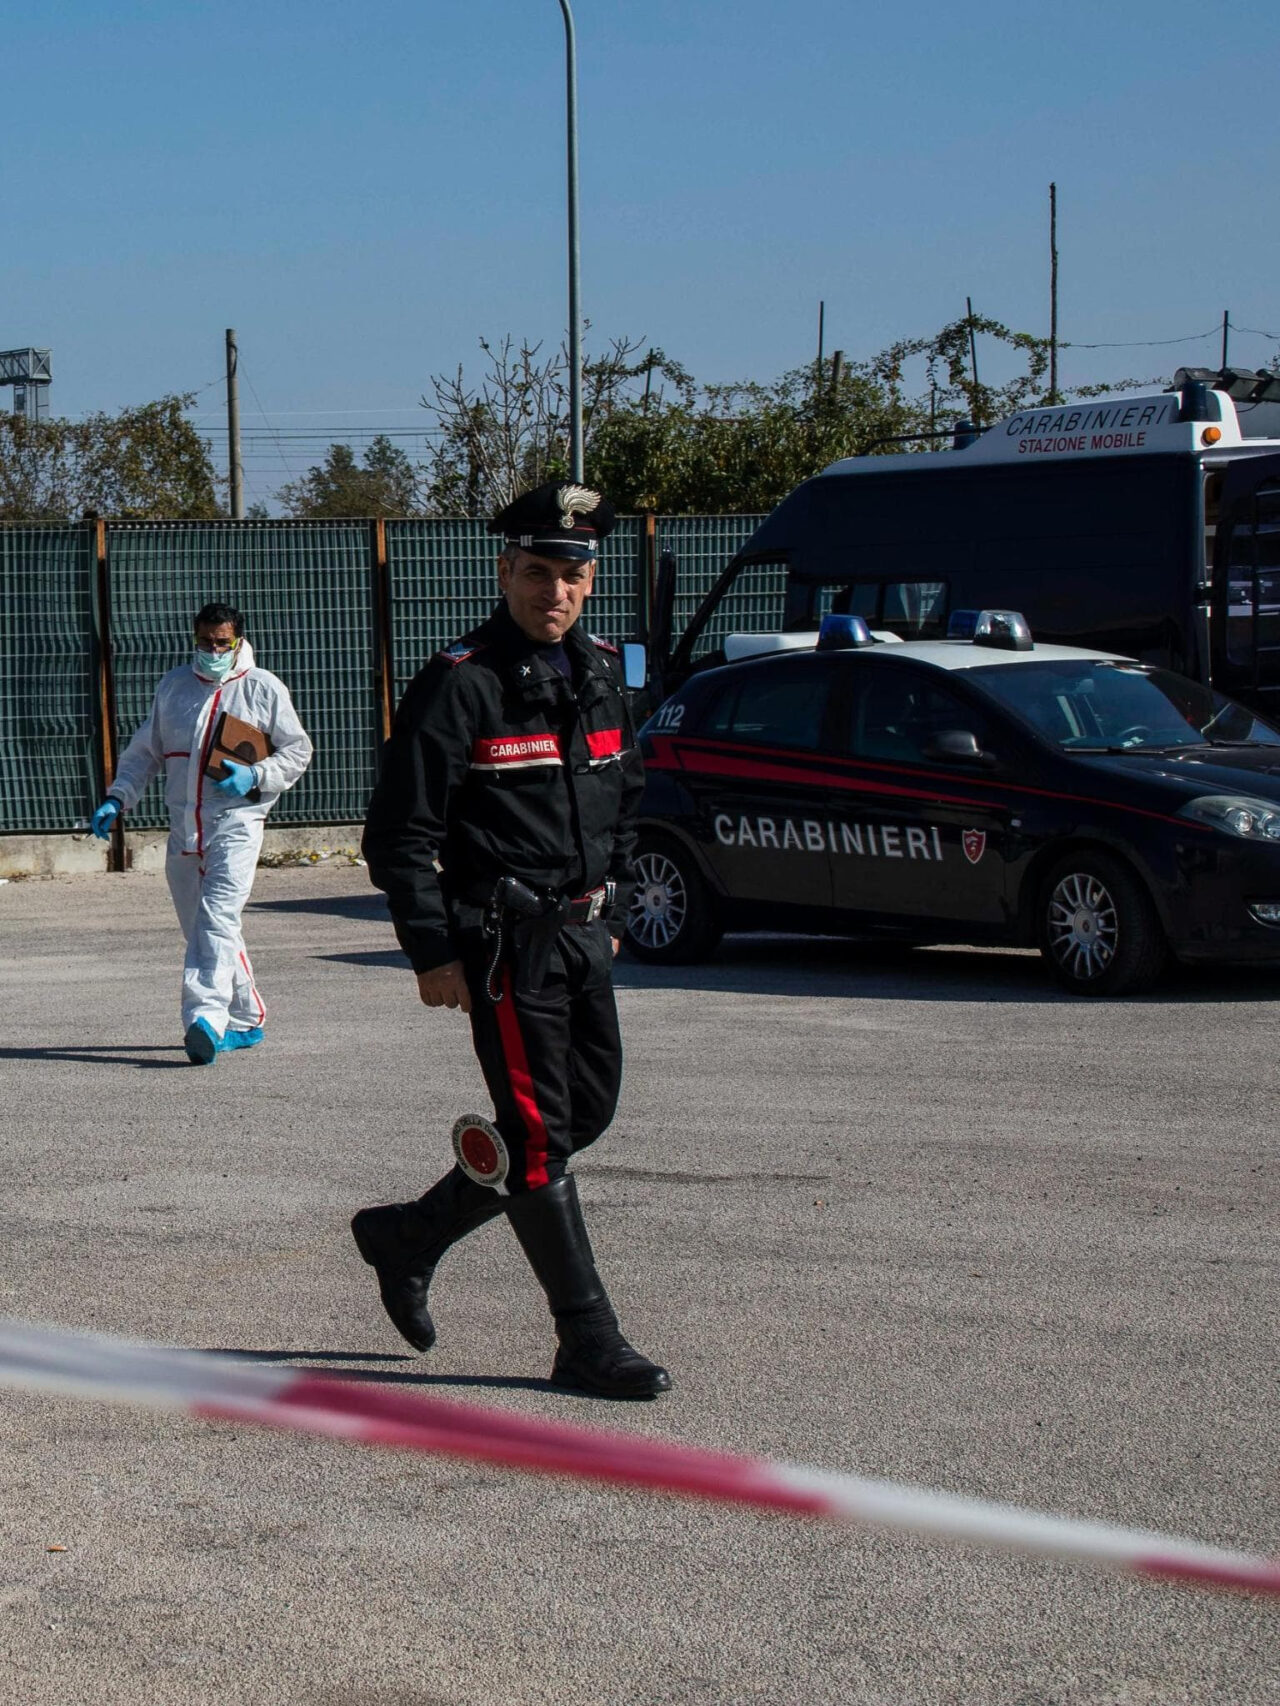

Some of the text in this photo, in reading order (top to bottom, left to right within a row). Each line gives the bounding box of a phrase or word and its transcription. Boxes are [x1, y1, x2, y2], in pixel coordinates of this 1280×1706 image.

[1006, 404, 1168, 437] CARABINIERI
[1019, 431, 1147, 454] STAZIONE MOBILE
[657, 704, 685, 727] 112
[490, 740, 557, 757] CARABINIER
[714, 814, 944, 861] CARABINIERI
